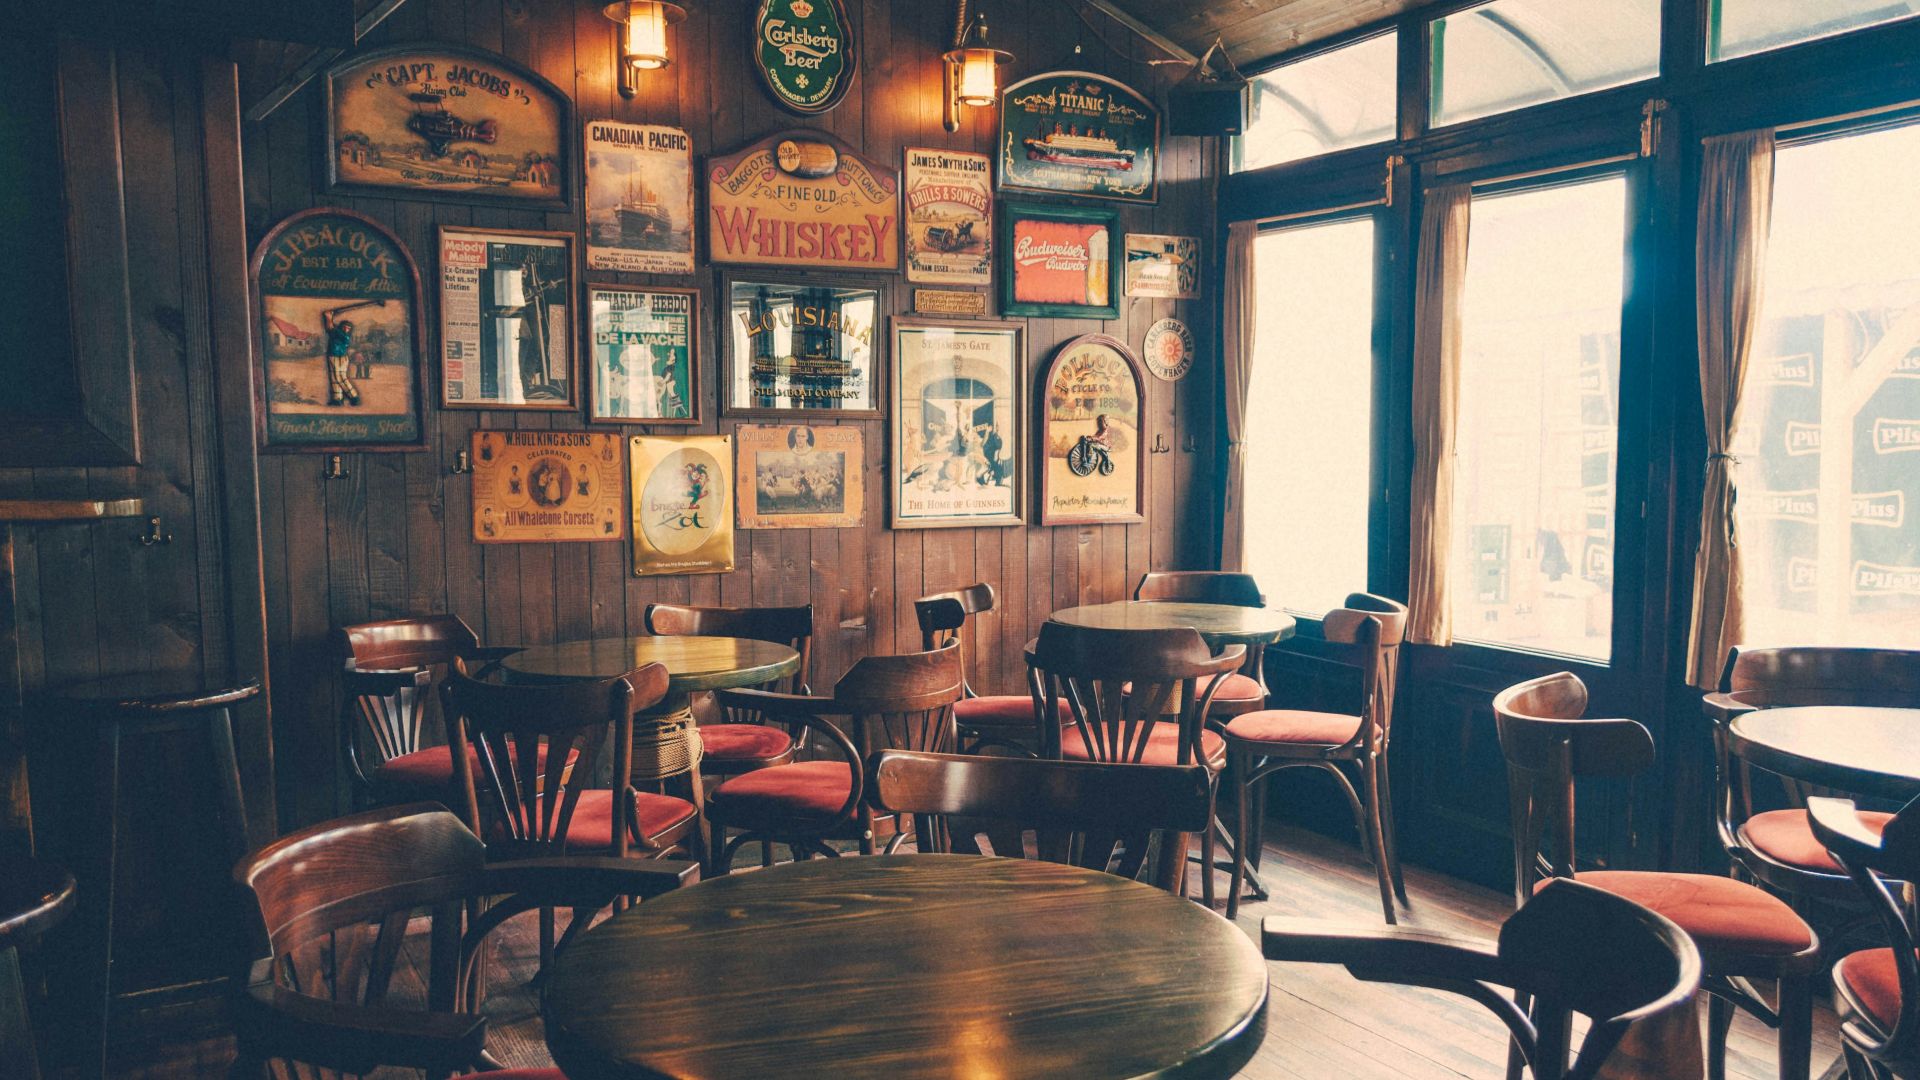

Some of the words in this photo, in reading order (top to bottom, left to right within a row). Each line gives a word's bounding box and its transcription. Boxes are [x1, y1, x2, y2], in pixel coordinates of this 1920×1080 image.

[765, 19, 838, 54] Carlsberg
[784, 47, 823, 70] Beer
[386, 62, 438, 87] CAPT.
[446, 64, 511, 98] JACOBS
[770, 68, 806, 103] COPENHAGEN
[810, 76, 834, 102] DENMARK
[449, 85, 467, 98] Club
[1060, 93, 1105, 111] TITANIC
[592, 125, 644, 146] CANADIAN
[648, 131, 687, 151] PACIFIC
[648, 146, 669, 154] WORLD
[911, 153, 937, 168] JAMES
[937, 155, 963, 169] SMYTH
[963, 159, 969, 171] &
[968, 158, 986, 172] SONS
[728, 152, 773, 193] BAGGOTS
[840, 158, 874, 193] HUTTON
[1104, 176, 1122, 187] YORK
[777, 185, 811, 201] FINE
[814, 187, 836, 202] OLD
[911, 187, 940, 208] DRILLS
[943, 187, 949, 201] &
[950, 188, 987, 212] SOWERS
[712, 205, 895, 263] WHISKEY
[444, 239, 485, 253] Melody
[1015, 236, 1089, 261] Budweiser
[302, 256, 329, 269] EST
[336, 257, 363, 269] 1881
[448, 250, 481, 264] Maker
[594, 254, 619, 263] CANADA
[594, 261, 610, 269] NEW
[612, 262, 641, 271] ZEALAND
[651, 265, 688, 273] AUSTRALIA
[972, 266, 988, 275] PARIS
[444, 274, 456, 283] Not
[444, 282, 471, 292] Lifetime
[651, 295, 688, 314] HEBDO
[738, 305, 872, 346] LOUISIANA
[598, 332, 619, 345] DE
[622, 333, 640, 345] LA
[640, 334, 687, 347] VACHE
[1148, 321, 1181, 350] CARLSBERG
[969, 340, 991, 352] GATE
[1149, 355, 1193, 379] COPENHAGEN
[753, 385, 813, 398] STEAMBOAT
[815, 387, 860, 400] COMPANY
[1071, 384, 1098, 393] CYCLE
[276, 420, 316, 434] Finest
[317, 419, 369, 437] Hickory
[537, 432, 559, 447] KING
[560, 436, 566, 447] &
[566, 432, 591, 447] SONS
[527, 449, 573, 461] CELEBRATED
[907, 500, 924, 510] THE
[927, 500, 951, 510] HOME
[953, 500, 963, 509] OF
[965, 499, 1005, 509] GUINNESS
[504, 511, 517, 526] All
[518, 511, 562, 526] Whalebone
[563, 510, 594, 526] Corsets
